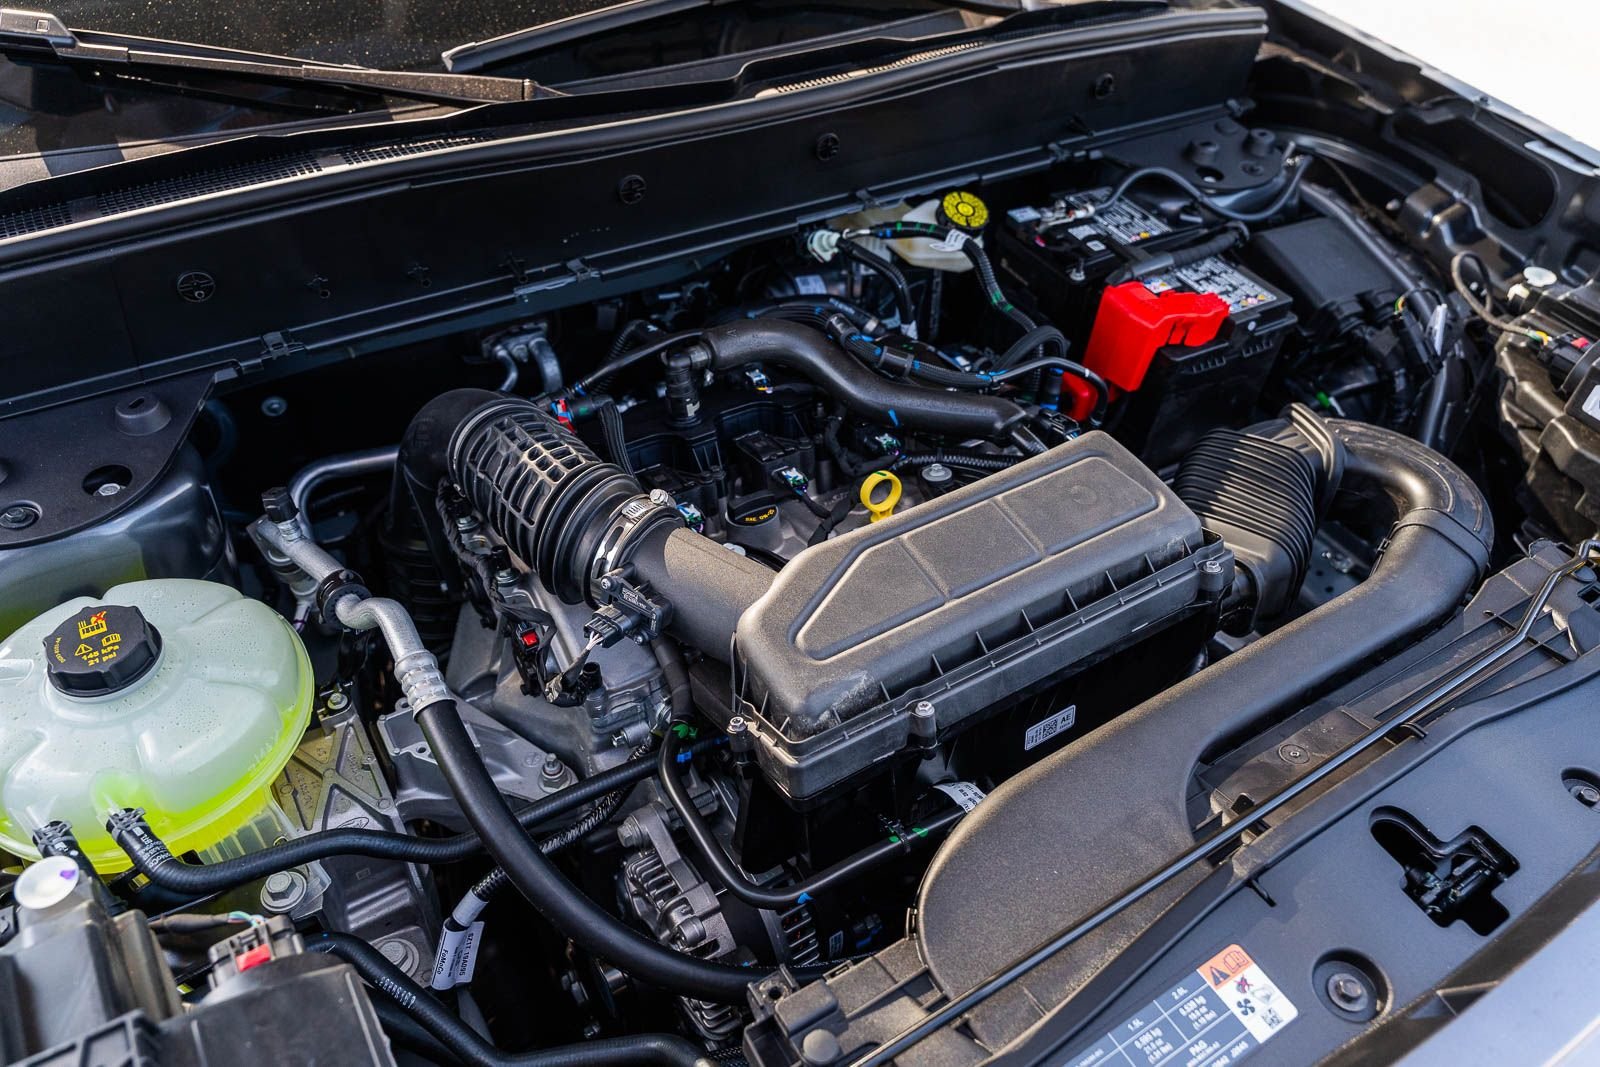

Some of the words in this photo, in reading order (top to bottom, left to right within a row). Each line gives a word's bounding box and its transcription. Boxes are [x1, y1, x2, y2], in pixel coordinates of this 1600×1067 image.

[101, 645, 120, 654] kPa
[102, 652, 117, 662] psi
[1060, 713, 1071, 724] AE
[437, 948, 449, 975] FoMoCo
